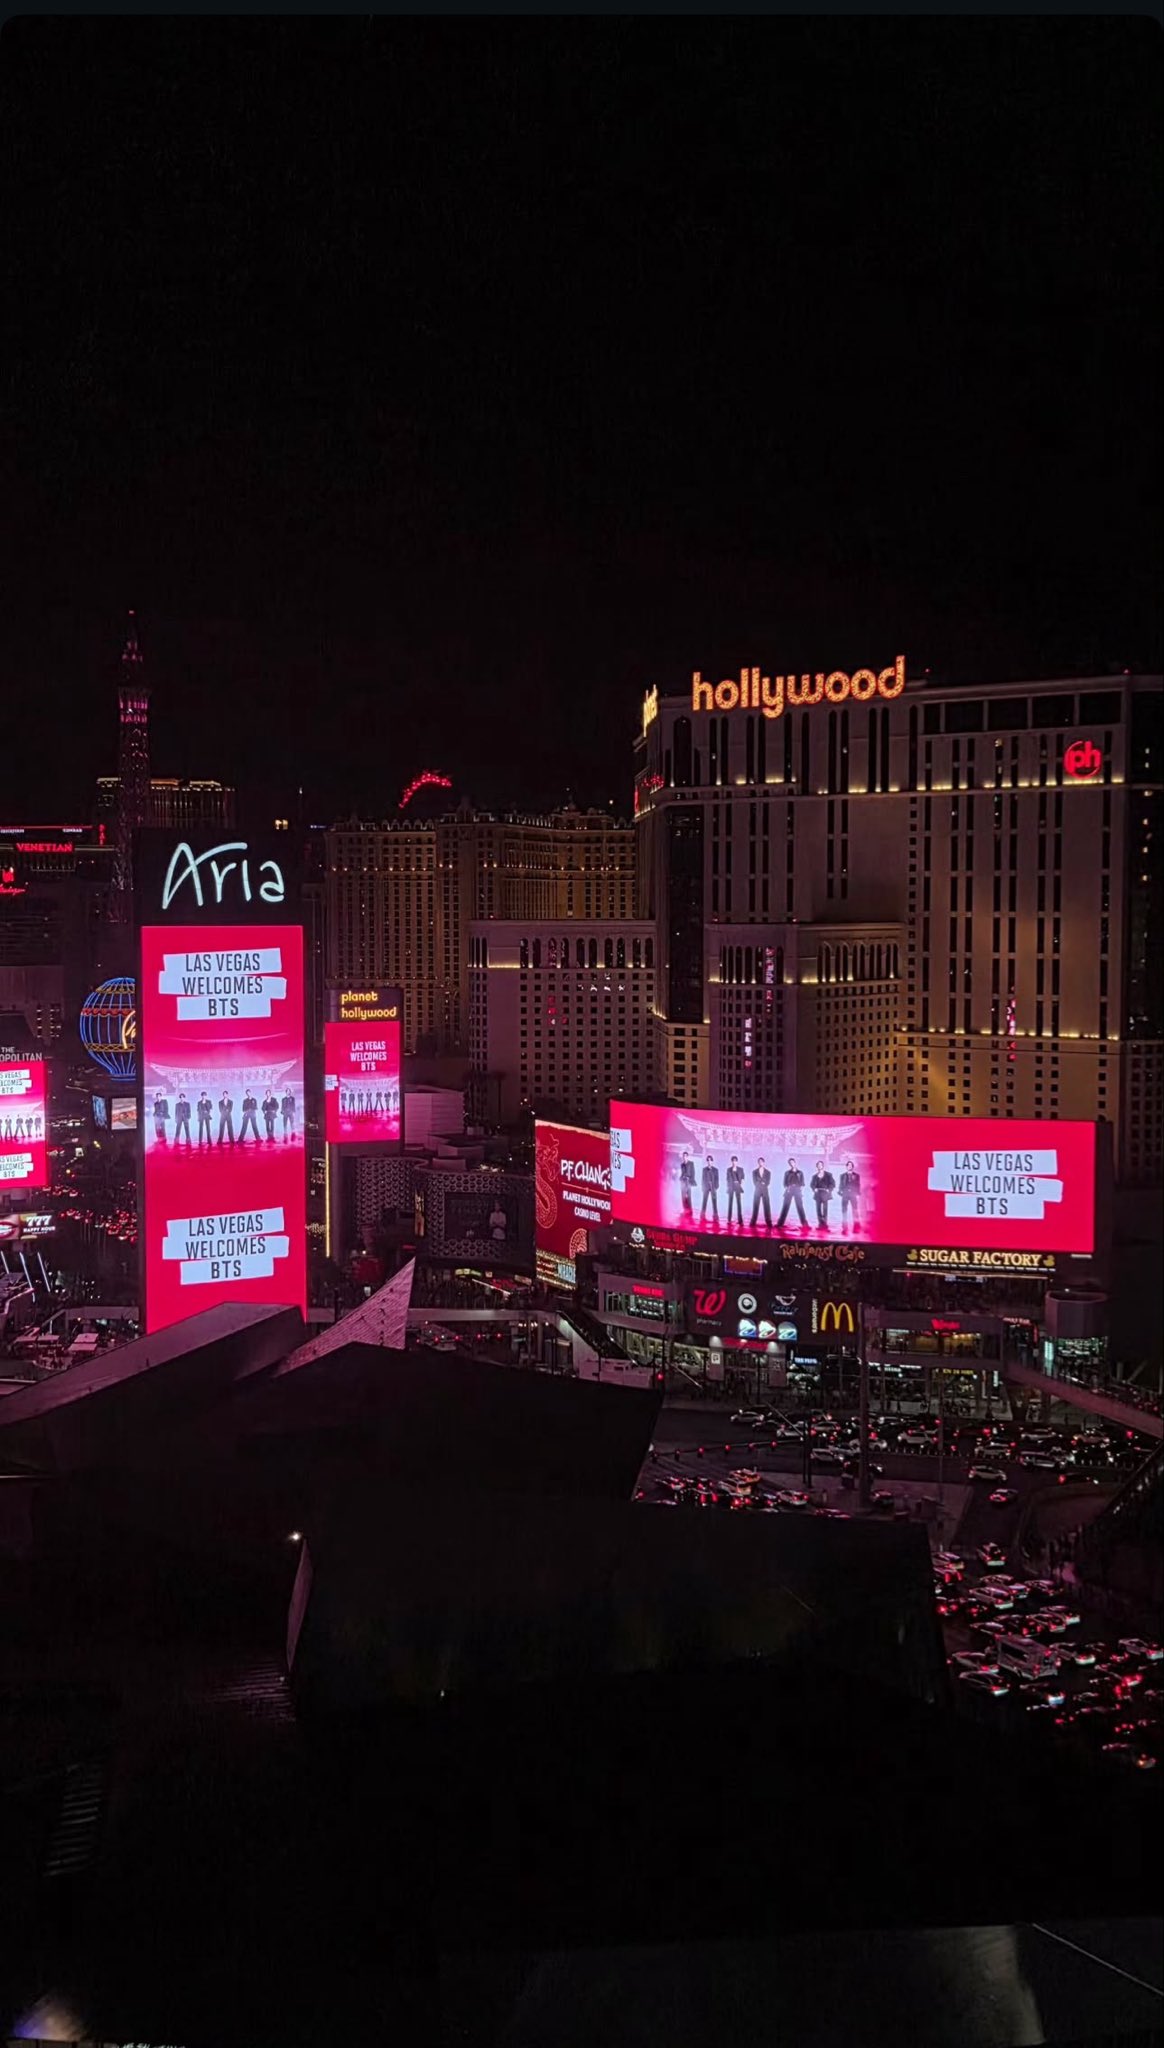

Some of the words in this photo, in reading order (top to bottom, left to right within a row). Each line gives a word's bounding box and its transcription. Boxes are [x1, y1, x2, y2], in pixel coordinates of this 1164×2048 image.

[692, 655, 905, 719] hollywood
[16, 842, 73, 853] VENETIAN
[162, 842, 285, 909] Aria
[185, 953, 212, 972] LAS
[215, 952, 261, 972] VEGAS
[182, 976, 263, 995] WELCOMES
[341, 991, 378, 1005] planet
[208, 998, 239, 1017] BTS
[341, 1006, 397, 1020] hollywood
[351, 1041, 364, 1051] LAS
[364, 1040, 386, 1050] VEGAS
[350, 1051, 387, 1062] WELCOMES
[5, 1071, 22, 1079] VEGAS
[361, 1062, 376, 1071] BTS
[954, 1152, 981, 1170] LAS
[985, 1152, 1033, 1172] VEGAS
[951, 1174, 1035, 1195] WELCOMES
[562, 1190, 581, 1203] PLANET
[574, 1206, 589, 1218] CASINO
[589, 1210, 602, 1223] LEVEL
[976, 1197, 1008, 1216] BTS
[26, 1214, 52, 1227] 777
[189, 1218, 214, 1236] LAS
[219, 1214, 263, 1234] VEGAS
[185, 1236, 266, 1260] WELCOMES
[920, 1249, 970, 1264] SUGAR
[972, 1251, 1042, 1267] FACTORY
[211, 1260, 242, 1279] BTS
